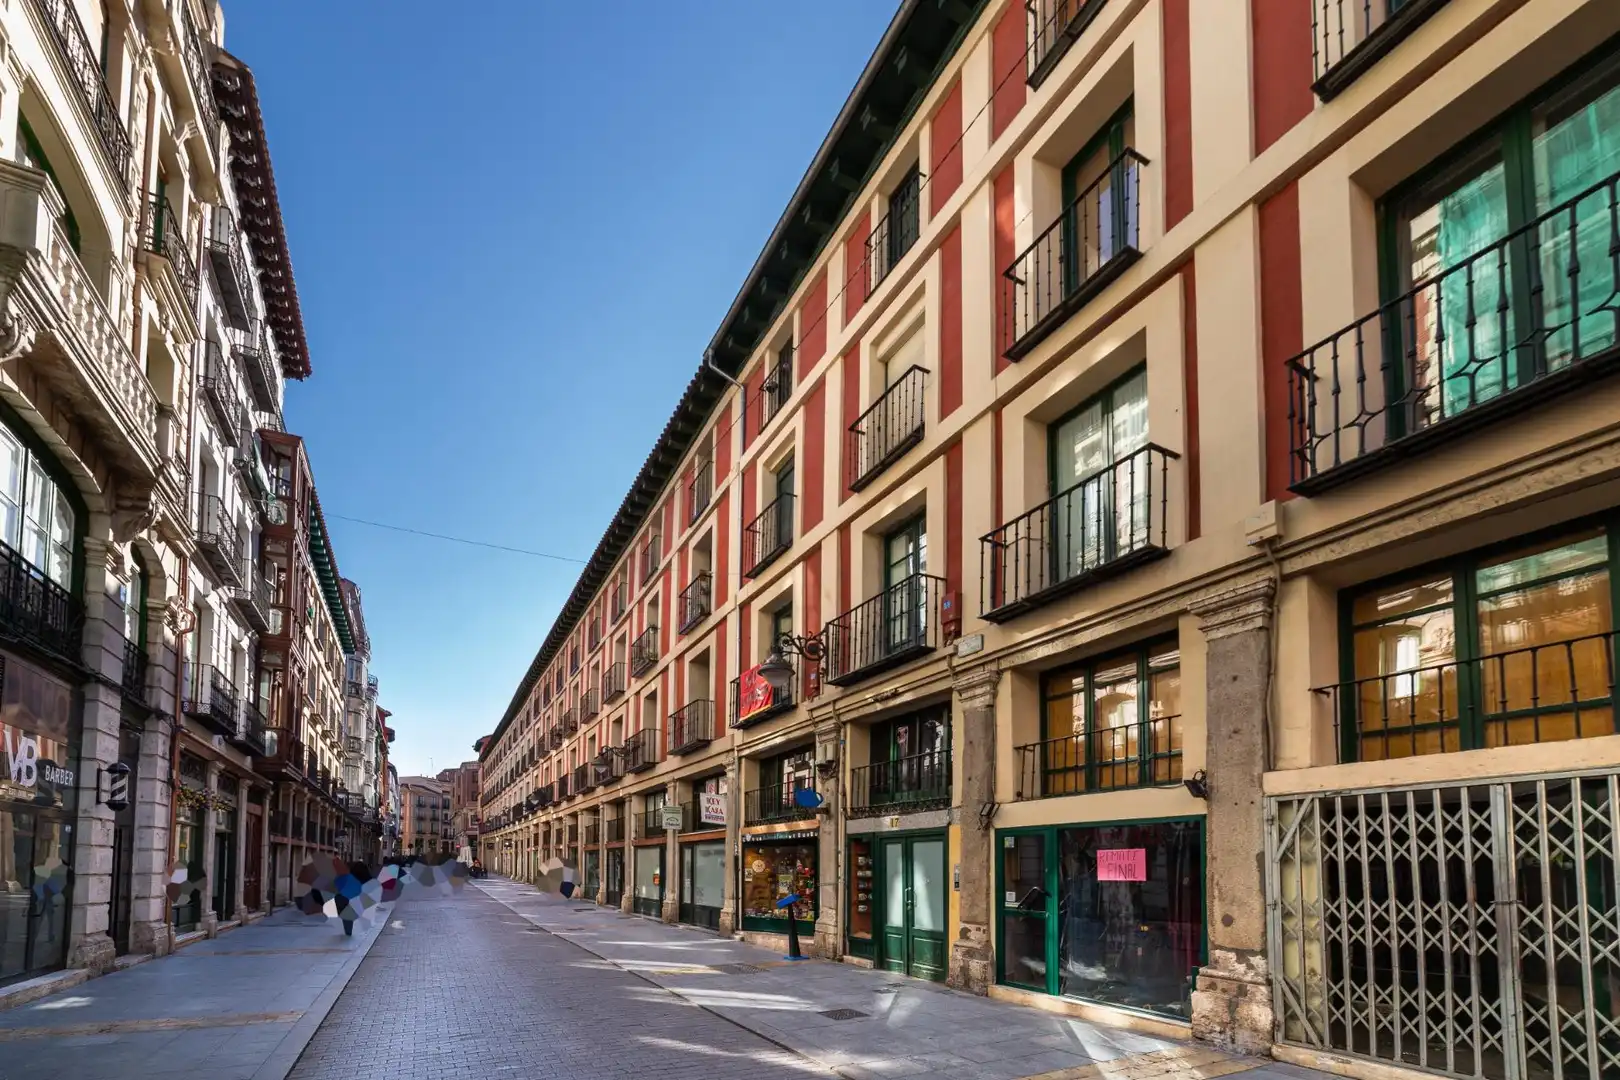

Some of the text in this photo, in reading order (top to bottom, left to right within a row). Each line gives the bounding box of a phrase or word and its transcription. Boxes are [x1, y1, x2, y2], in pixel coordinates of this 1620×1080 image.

[45, 765, 74, 786] BARBER
[891, 817, 899, 828] 17
[1108, 862, 1138, 880] FINAL
